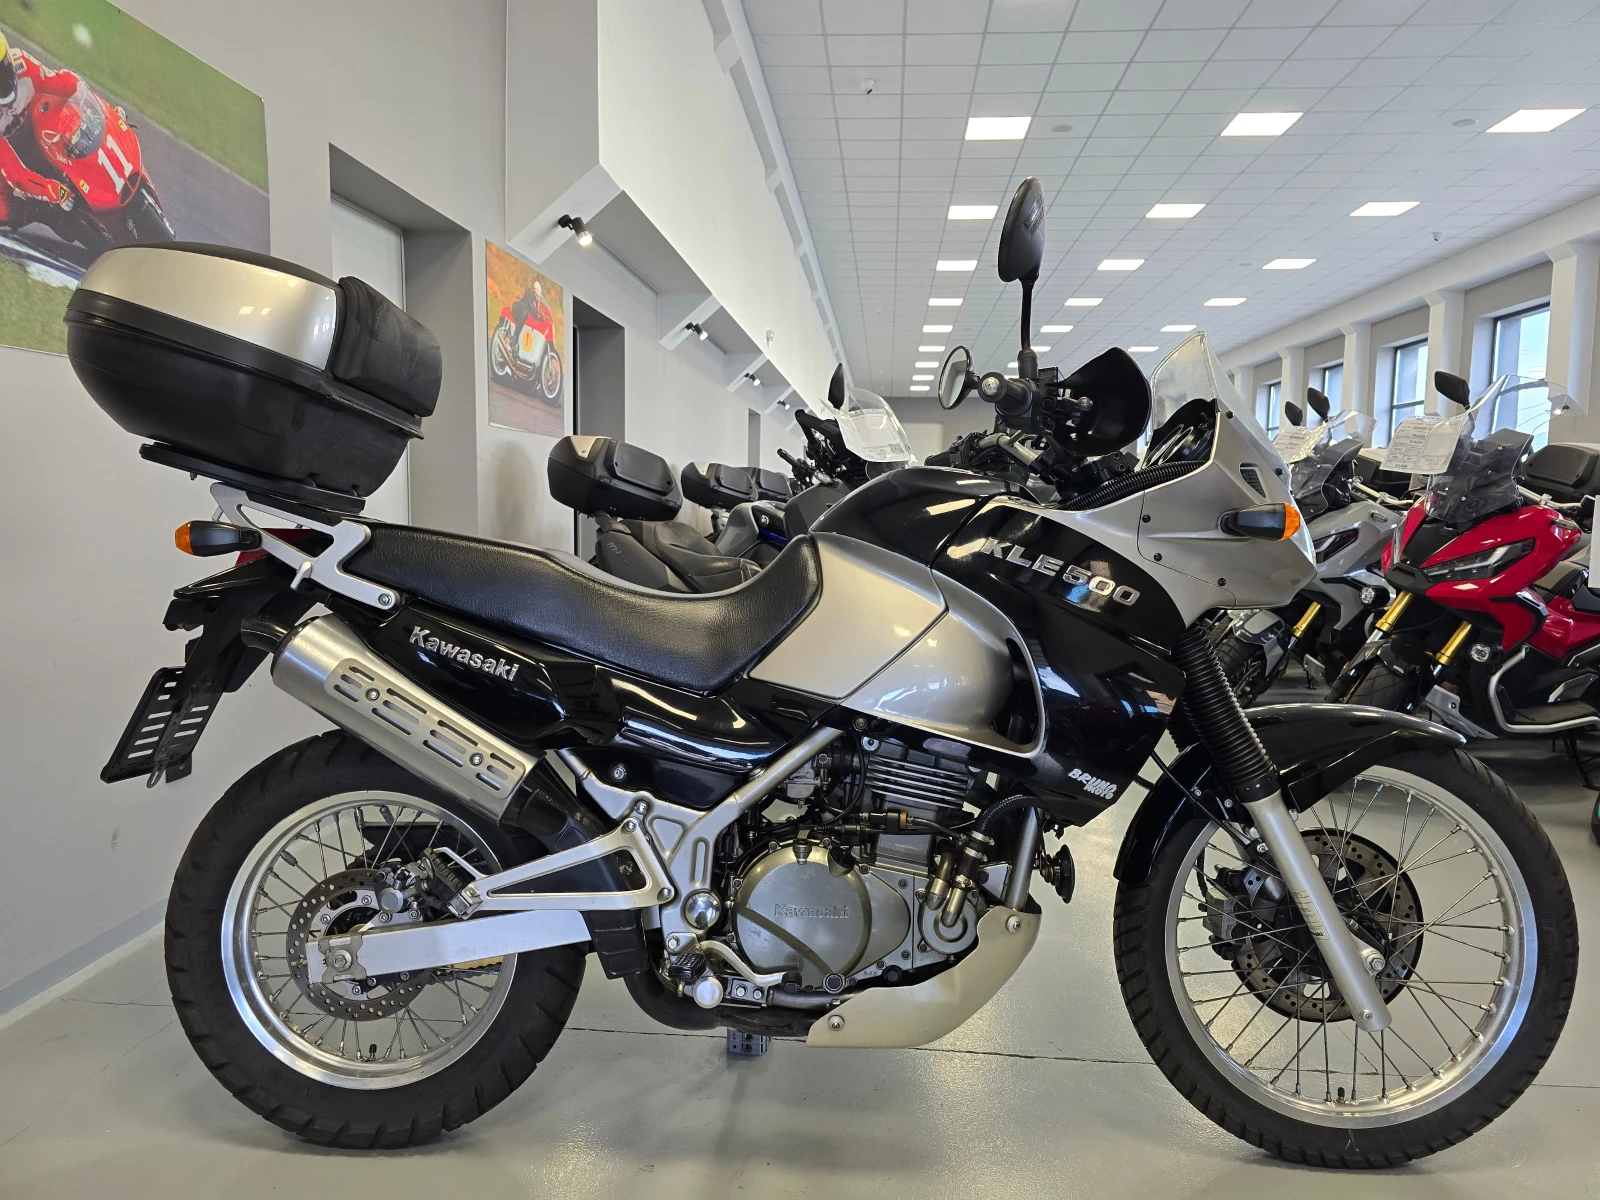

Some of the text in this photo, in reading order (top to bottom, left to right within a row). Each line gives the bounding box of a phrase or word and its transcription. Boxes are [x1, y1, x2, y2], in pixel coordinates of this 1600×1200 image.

[98, 134, 133, 194] 11
[980, 537, 1141, 607] KLE500
[408, 625, 520, 682] Kawasaki
[1068, 768, 1117, 793] BRUNO
[774, 903, 849, 919] Kawasaki
